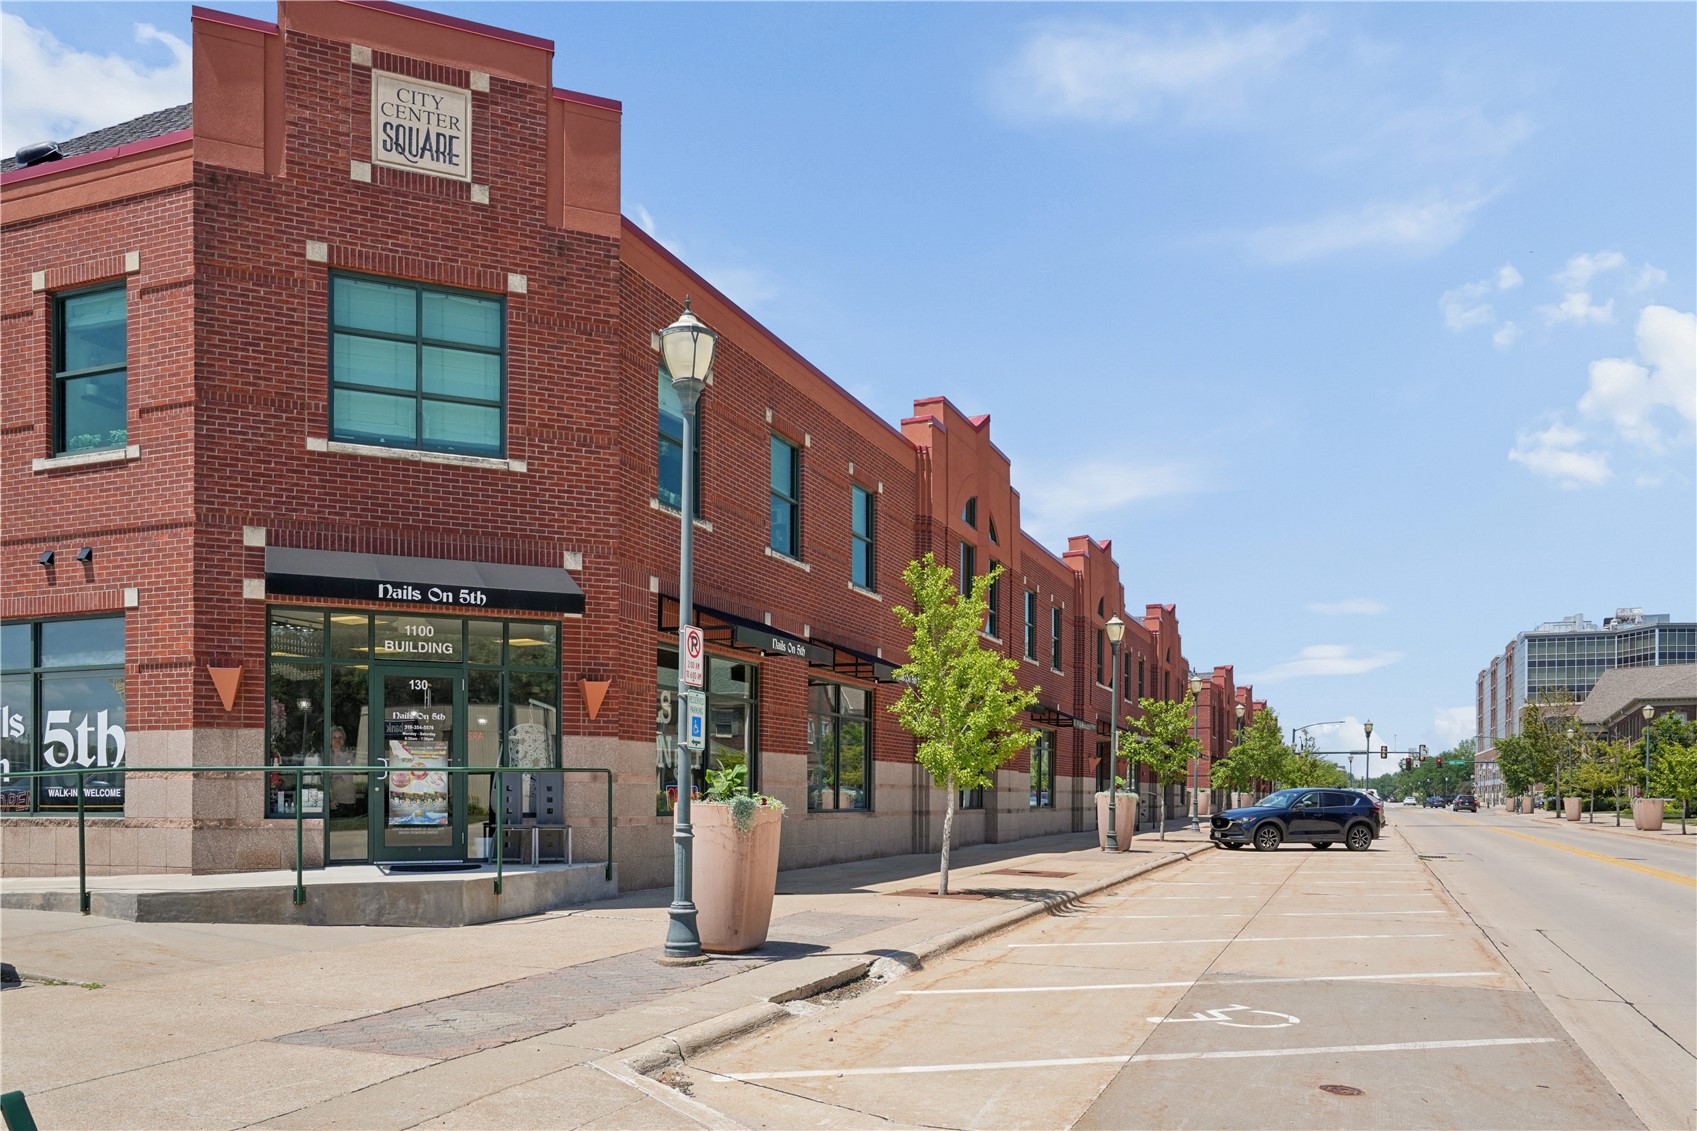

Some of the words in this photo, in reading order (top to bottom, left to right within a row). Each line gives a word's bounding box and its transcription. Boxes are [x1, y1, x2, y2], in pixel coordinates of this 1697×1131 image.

[397, 88, 444, 110] CITY
[381, 102, 461, 131] CENTER
[382, 121, 460, 166] SQUARE
[378, 584, 422, 600] Nails
[428, 587, 453, 602] On
[459, 589, 487, 606] 5th
[405, 625, 434, 637] 1100
[384, 640, 453, 654] BUILDING
[772, 638, 786, 651] Nails
[787, 642, 796, 654] On
[797, 644, 805, 657] 5th
[409, 680, 428, 690] 130
[416, 712, 429, 720] On
[432, 712, 446, 720] 5th
[43, 709, 125, 769] 5th
[84, 788, 121, 797] WELCOME
